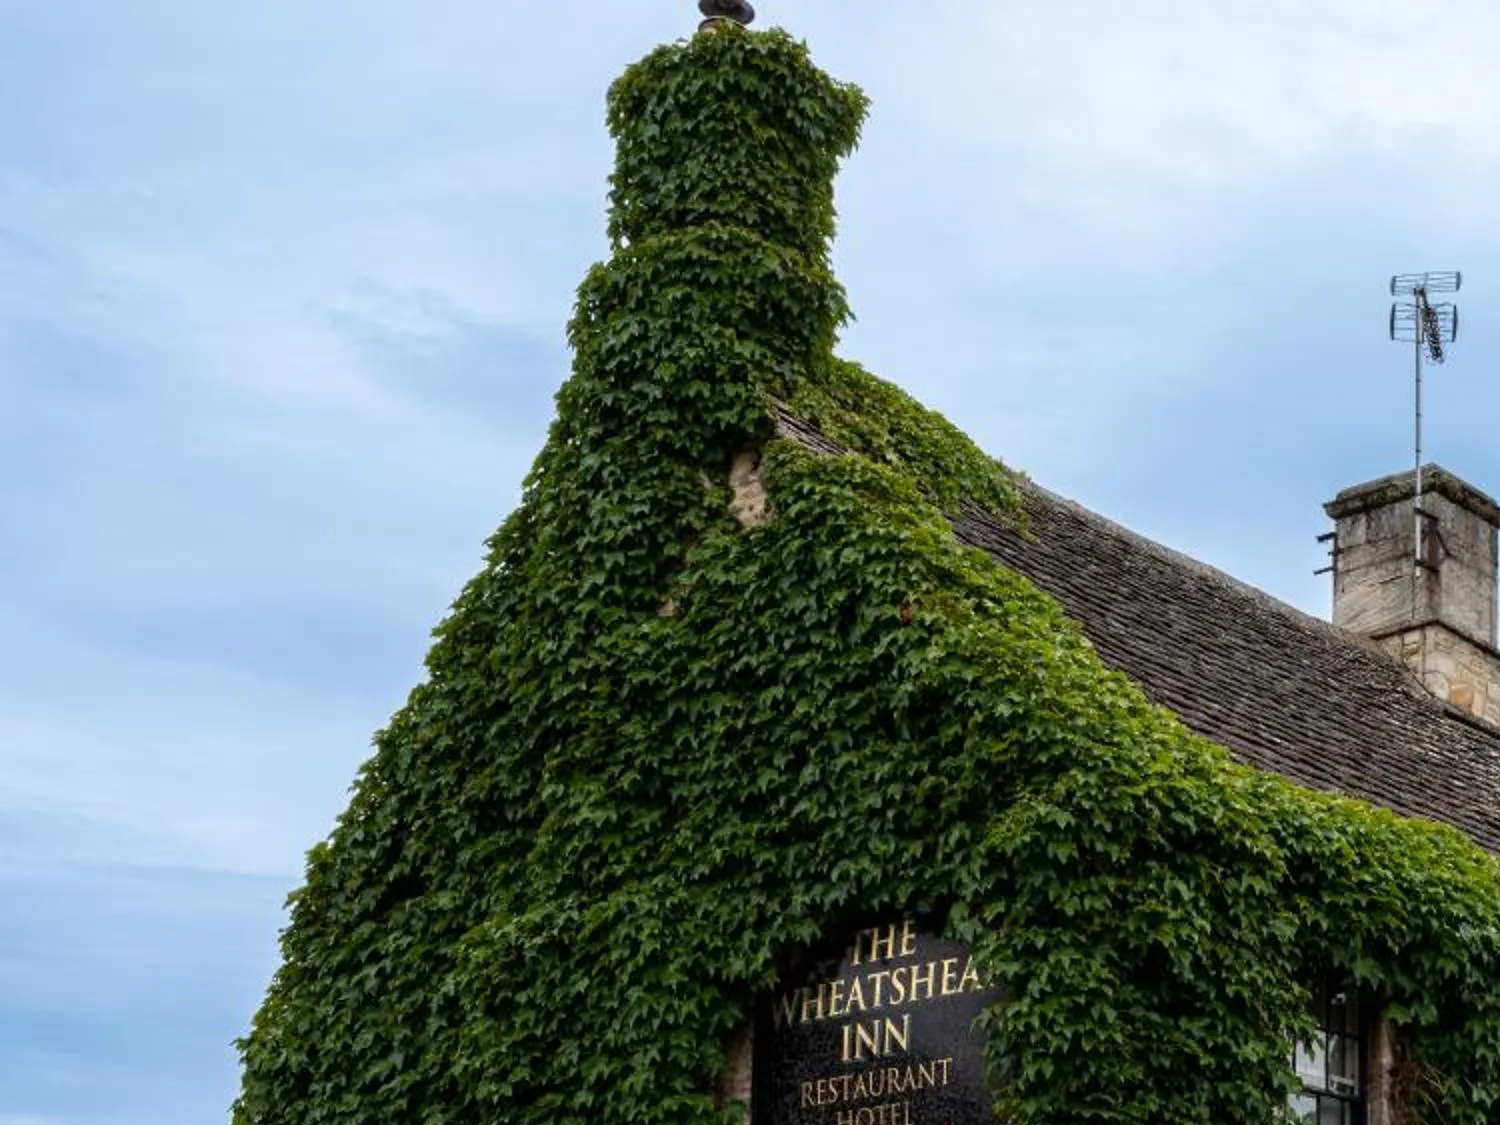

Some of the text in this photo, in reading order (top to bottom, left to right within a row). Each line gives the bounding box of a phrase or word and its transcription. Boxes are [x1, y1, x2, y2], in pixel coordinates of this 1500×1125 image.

[851, 918, 917, 966] THE
[771, 954, 995, 1029] WHEATSHEA
[841, 1013, 911, 1062] INN
[801, 1057, 953, 1108] RESTAURANT
